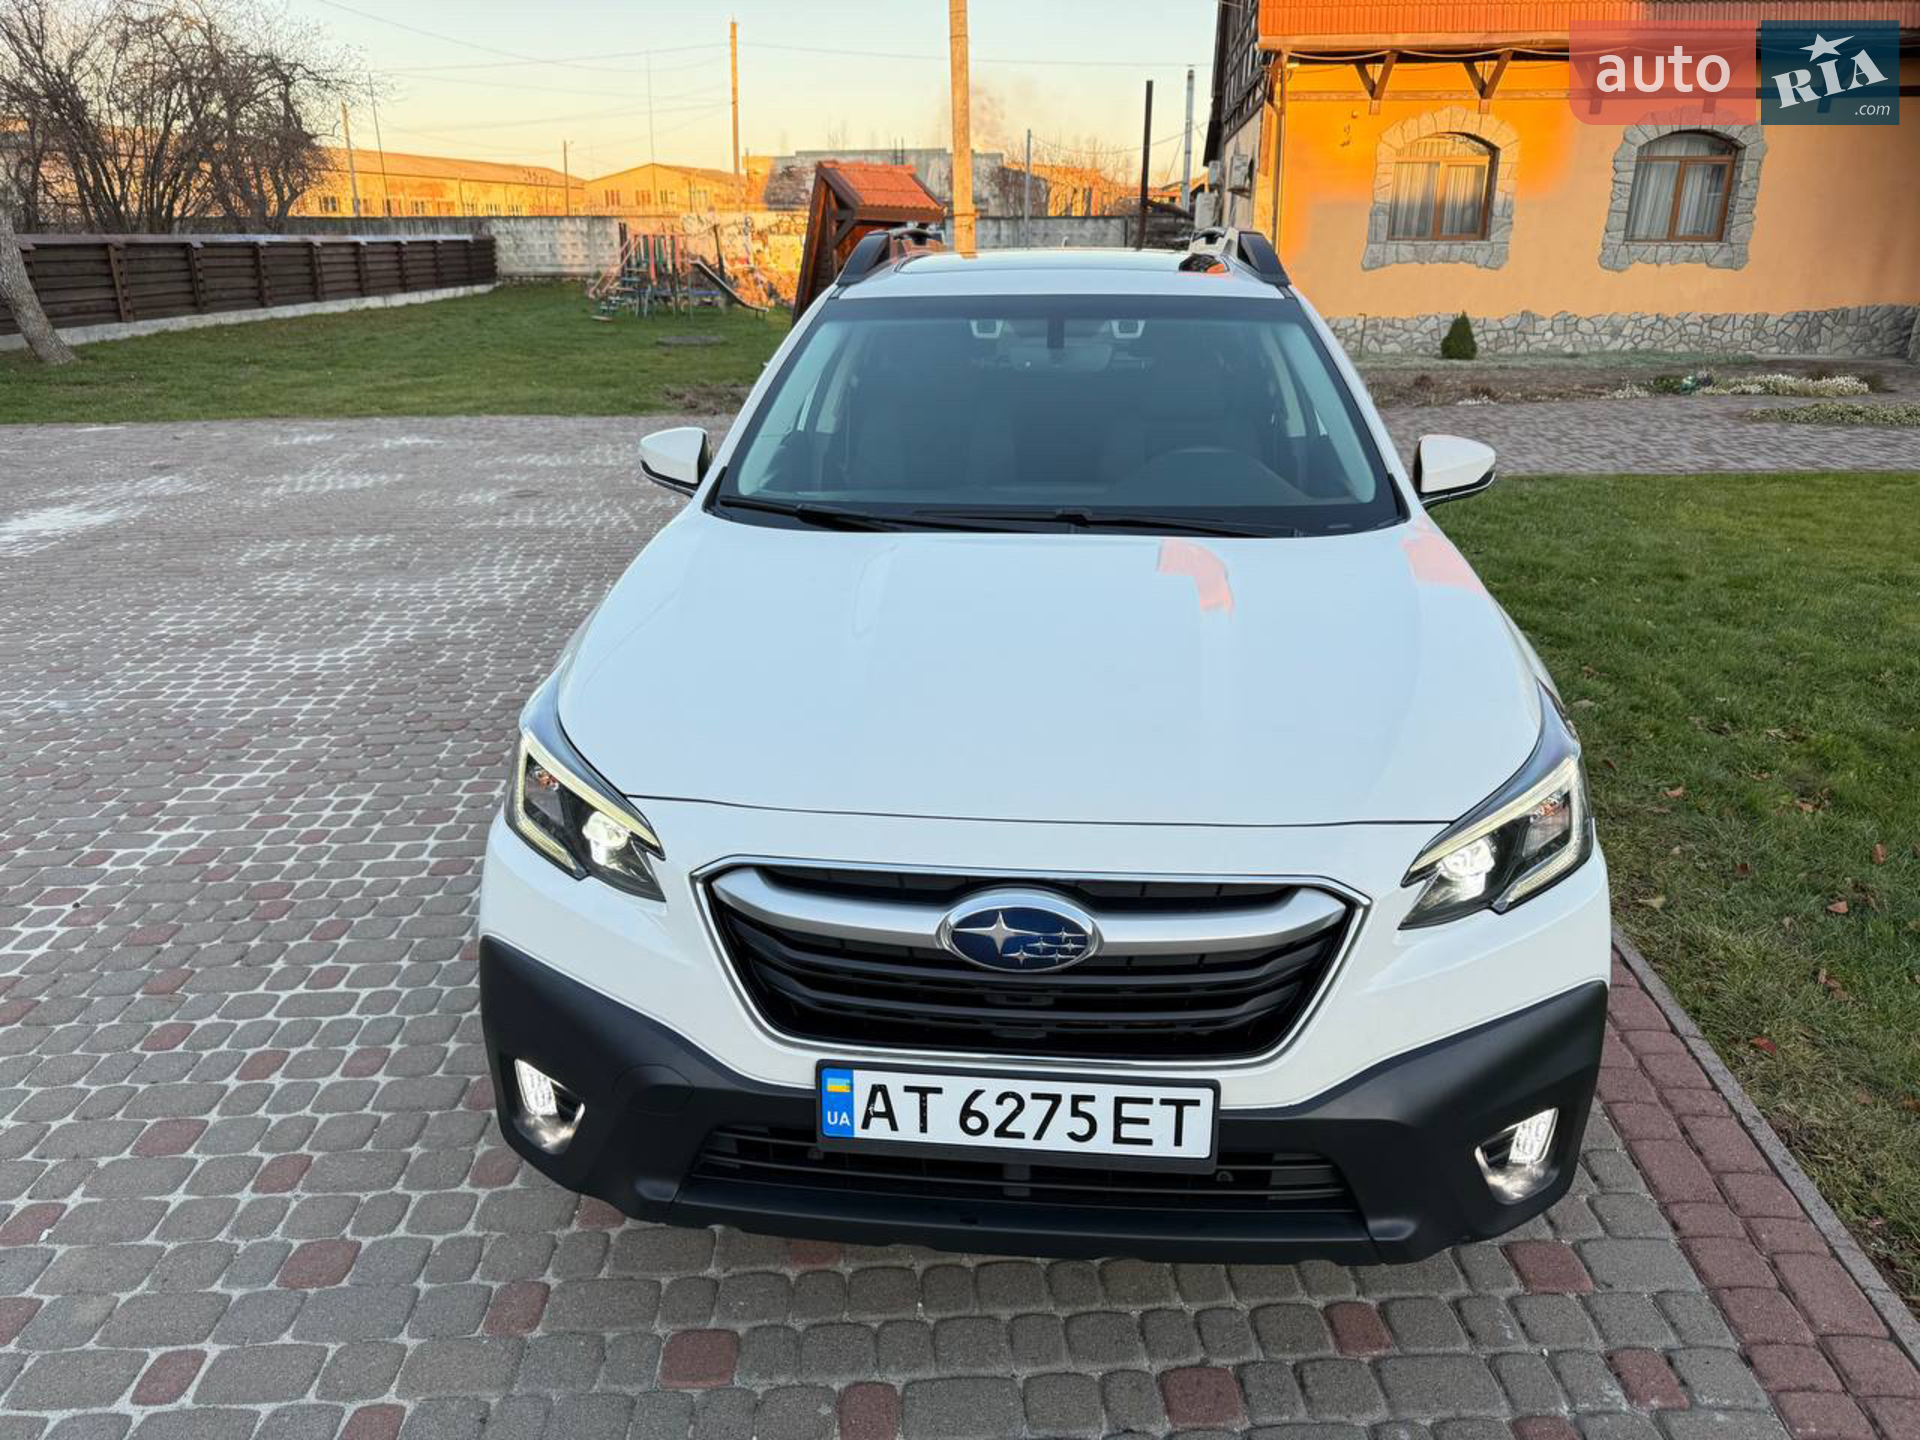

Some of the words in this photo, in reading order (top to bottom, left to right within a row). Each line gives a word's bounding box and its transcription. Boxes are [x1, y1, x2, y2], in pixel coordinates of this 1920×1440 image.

[827, 1110, 850, 1126] UA
[861, 1084, 943, 1134] AT
[958, 1089, 1099, 1143] 6275
[1112, 1096, 1201, 1147] ET
